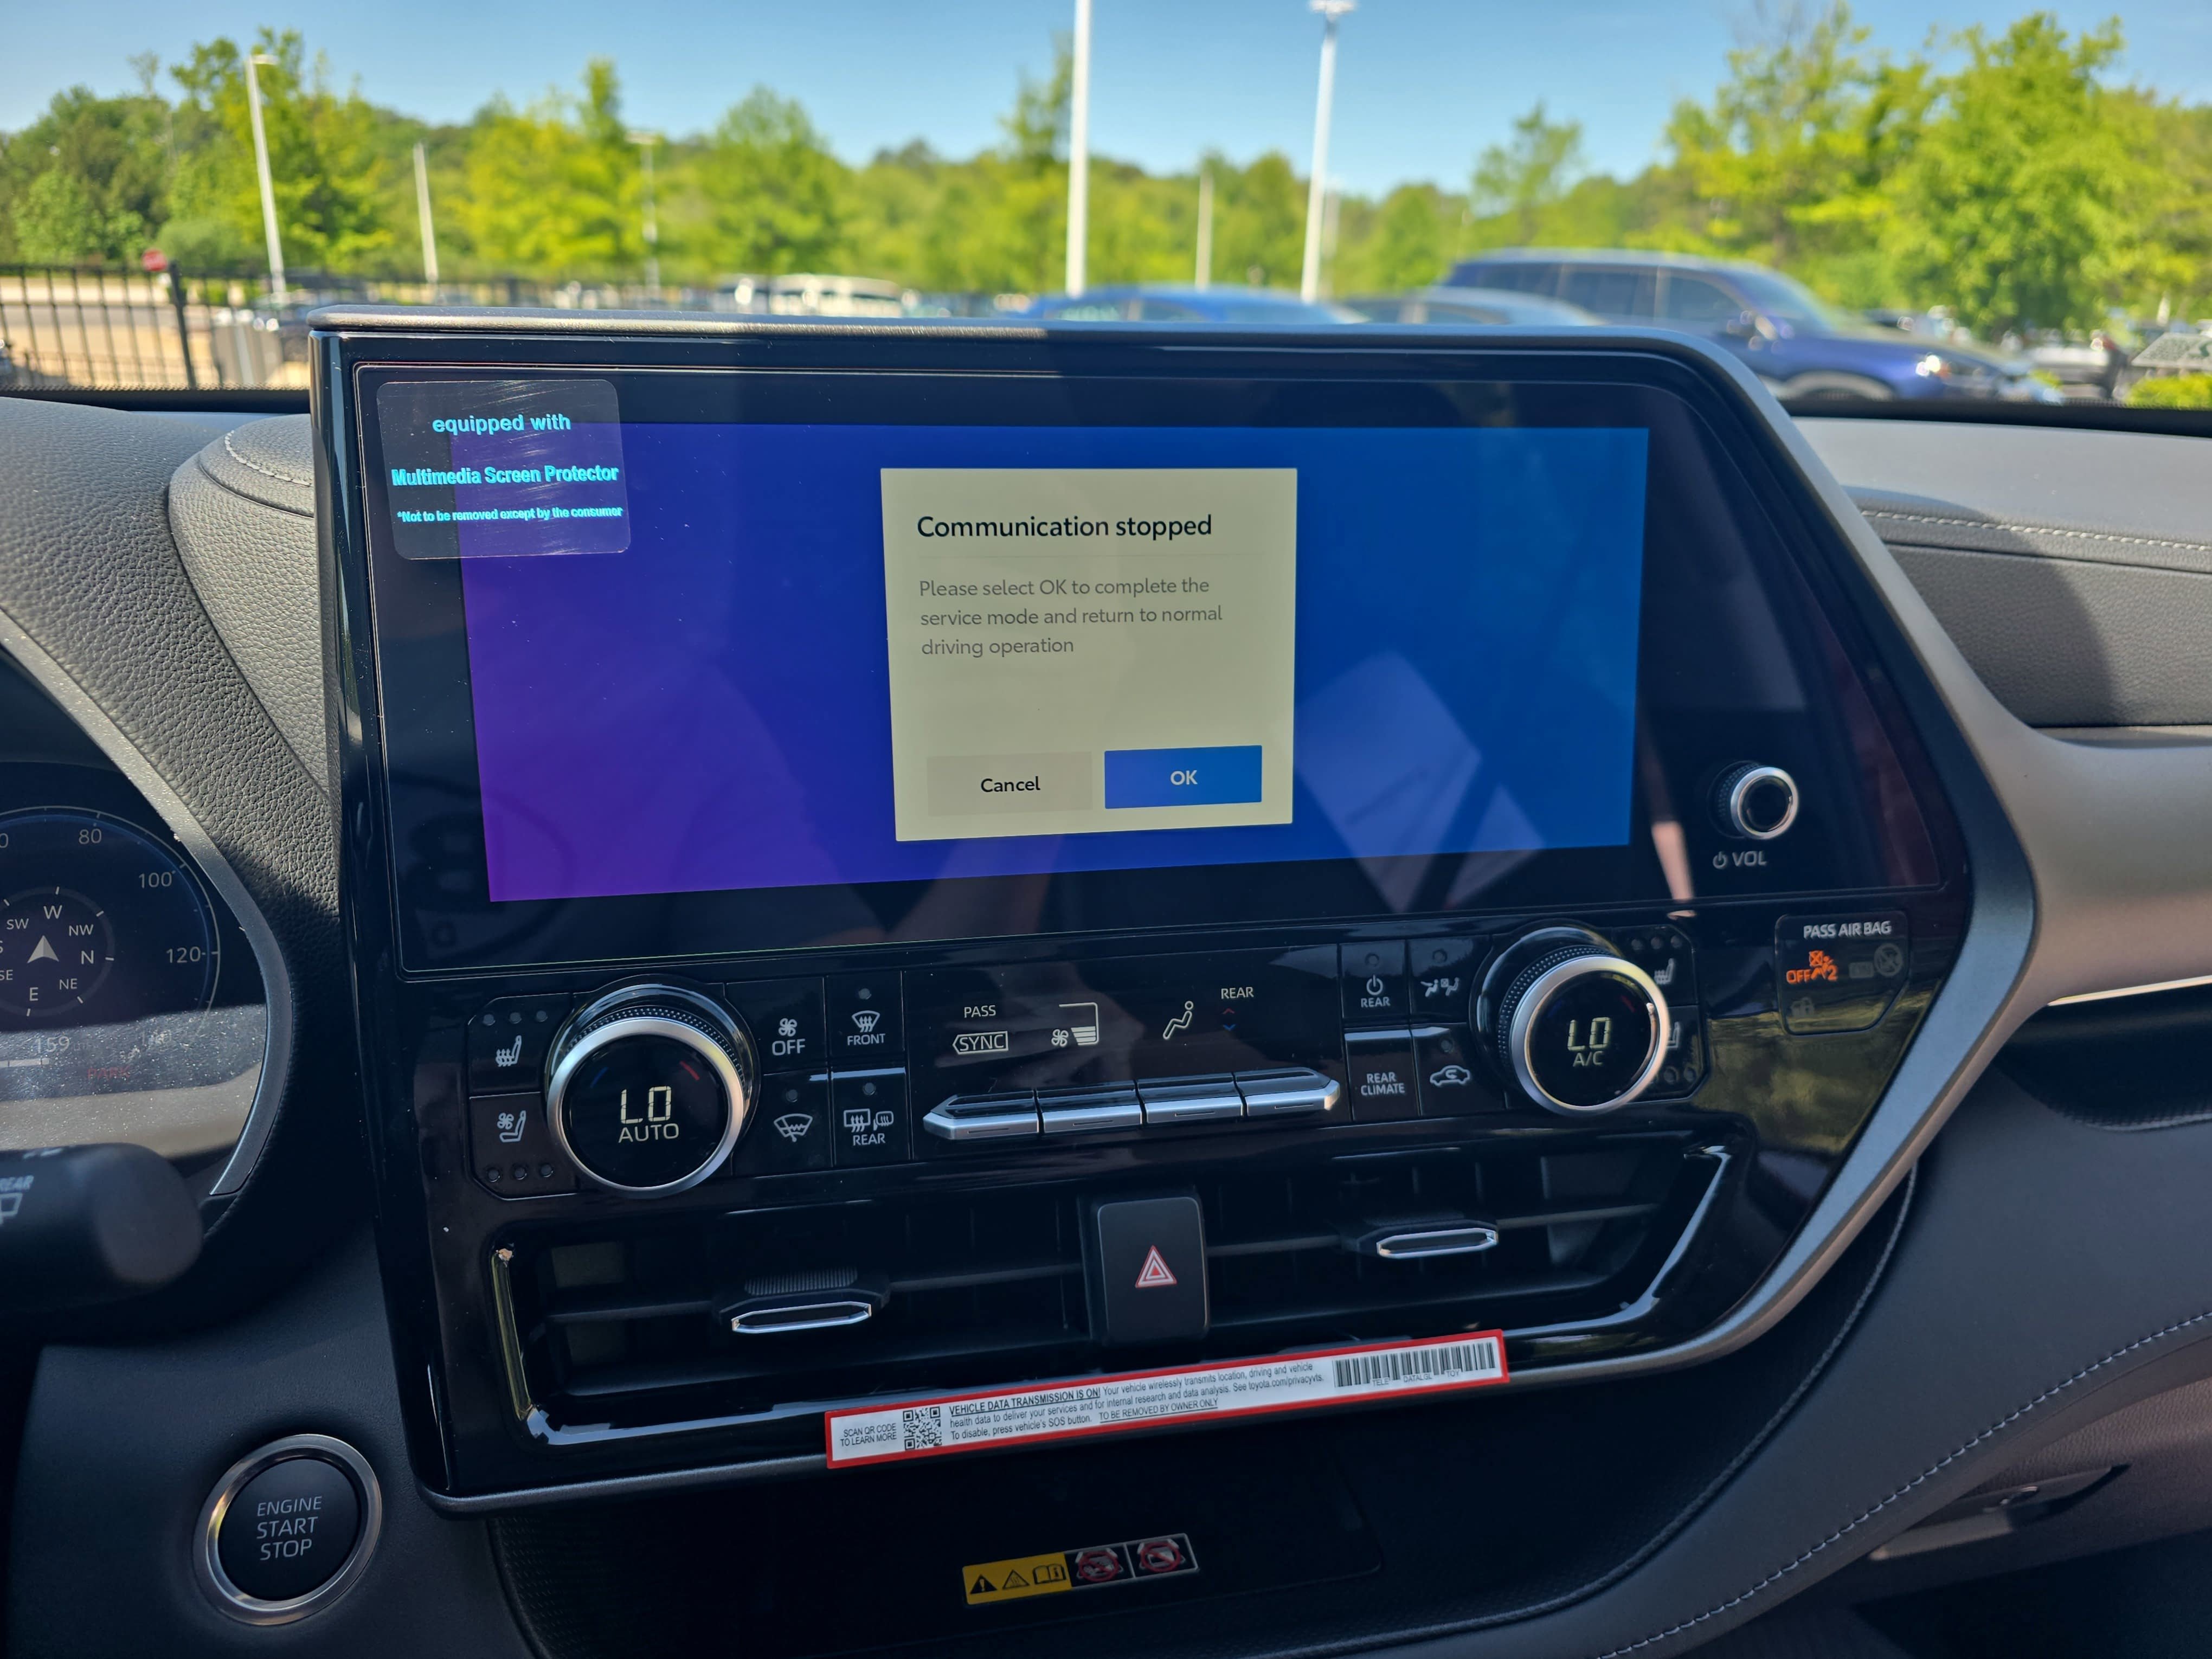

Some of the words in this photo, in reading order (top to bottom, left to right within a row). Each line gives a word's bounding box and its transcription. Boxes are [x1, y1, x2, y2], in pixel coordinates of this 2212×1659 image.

[432, 414, 525, 435] equipped
[530, 413, 571, 430] with
[391, 467, 482, 486] Multimedia
[484, 465, 541, 484] Screen
[544, 465, 620, 482] Protector
[423, 512, 435, 522] to
[436, 510, 451, 522] be
[452, 509, 498, 521] removed
[500, 508, 536, 522] except
[537, 508, 550, 521] by
[552, 507, 570, 519] the
[570, 506, 623, 518] consumer
[917, 515, 1109, 538] Communication
[1115, 515, 1213, 541] stopped
[919, 580, 978, 597] Please
[982, 578, 1035, 596] select
[1039, 580, 1068, 595] OK
[1071, 581, 1091, 595] to
[1094, 578, 1178, 599] complete
[1181, 577, 1210, 593] the
[921, 609, 982, 627] service
[987, 608, 1039, 625] mode
[1044, 608, 1078, 624] and
[1082, 608, 1135, 623] return
[1139, 608, 1158, 622] to
[1161, 605, 1223, 622] normal
[921, 639, 984, 658] driving
[989, 638, 1075, 658] operation
[980, 776, 1041, 793] Cancel
[1170, 770, 1198, 786] OK
[78, 828, 102, 844] 80
[1732, 850, 1767, 867] VOL
[138, 871, 173, 889] 100
[43, 905, 62, 919] W
[7, 918, 29, 930] SW
[68, 924, 94, 936] NW
[1803, 924, 1837, 939] PASS
[1838, 922, 1862, 937] AIR
[1863, 921, 1893, 935] BAG
[81, 950, 95, 964] N
[166, 947, 201, 963] 120
[59, 978, 78, 990] NE
[1786, 969, 1811, 984] OFF
[29, 987, 38, 1001] E
[1220, 986, 1255, 1000] REAR
[1360, 996, 1391, 1008] REAR
[963, 1004, 996, 1019] PASS
[847, 1032, 886, 1046] FRONT
[959, 1034, 1005, 1052] SYNC
[772, 1038, 806, 1057] OFF
[1572, 1051, 1604, 1068] A/C
[1366, 1071, 1397, 1084] REAR
[1360, 1083, 1405, 1096] CLIMATE
[618, 1123, 679, 1144] AUTO
[852, 1133, 886, 1147] REAR
[949, 1402, 985, 1416] VEHICLE
[988, 1399, 1009, 1411] DATA
[1011, 1393, 1074, 1408] TRANSMISSION
[1076, 1389, 1084, 1399] IS
[1086, 1387, 1101, 1398] ON!
[1102, 1385, 1120, 1396] Your
[1122, 1383, 1146, 1393] vehicle
[1149, 1378, 1182, 1391] wirelessly
[1184, 1373, 1216, 1385] transmits
[1218, 1371, 1247, 1382] location,
[1249, 1367, 1272, 1378] driving
[1274, 1366, 1287, 1374] and
[1289, 1362, 1313, 1372] vehicle
[950, 1416, 973, 1428] health
[975, 1414, 991, 1425] data
[993, 1413, 1001, 1422] to
[1003, 1410, 1027, 1421] deliver
[1030, 1407, 1045, 1419] your
[1047, 1404, 1078, 1415] services
[1079, 1400, 1094, 1410] and
[1095, 1399, 1105, 1409] for
[1107, 1396, 1133, 1408] internal
[1135, 1392, 1166, 1403] research
[1168, 1388, 1182, 1399] and
[1184, 1387, 1199, 1397] data
[1200, 1384, 1231, 1397] analysis.
[1232, 1382, 1247, 1392] See
[951, 1430, 960, 1441] To
[962, 1426, 991, 1439] disable,
[992, 1425, 1013, 1436] press
[1015, 1419, 1047, 1431] vehicle's
[1049, 1417, 1065, 1427] SOS
[1068, 1414, 1092, 1425] button.
[1099, 1411, 1109, 1421] TO
[1111, 1409, 1120, 1419] BE
[1122, 1405, 1159, 1417] REMOVED
[1160, 1404, 1170, 1412] BY
[1171, 1400, 1199, 1411] OWNER
[1199, 1397, 1219, 1408] ONLY
[843, 1427, 863, 1438] SCAN
[864, 1426, 875, 1435] QR
[876, 1423, 897, 1433] CODE
[840, 1438, 850, 1447] TO
[852, 1435, 875, 1445] LEARN
[876, 1431, 897, 1442] MORE
[256, 1495, 322, 1517] ENGINE
[256, 1516, 319, 1540] START
[260, 1538, 313, 1561] STOP
